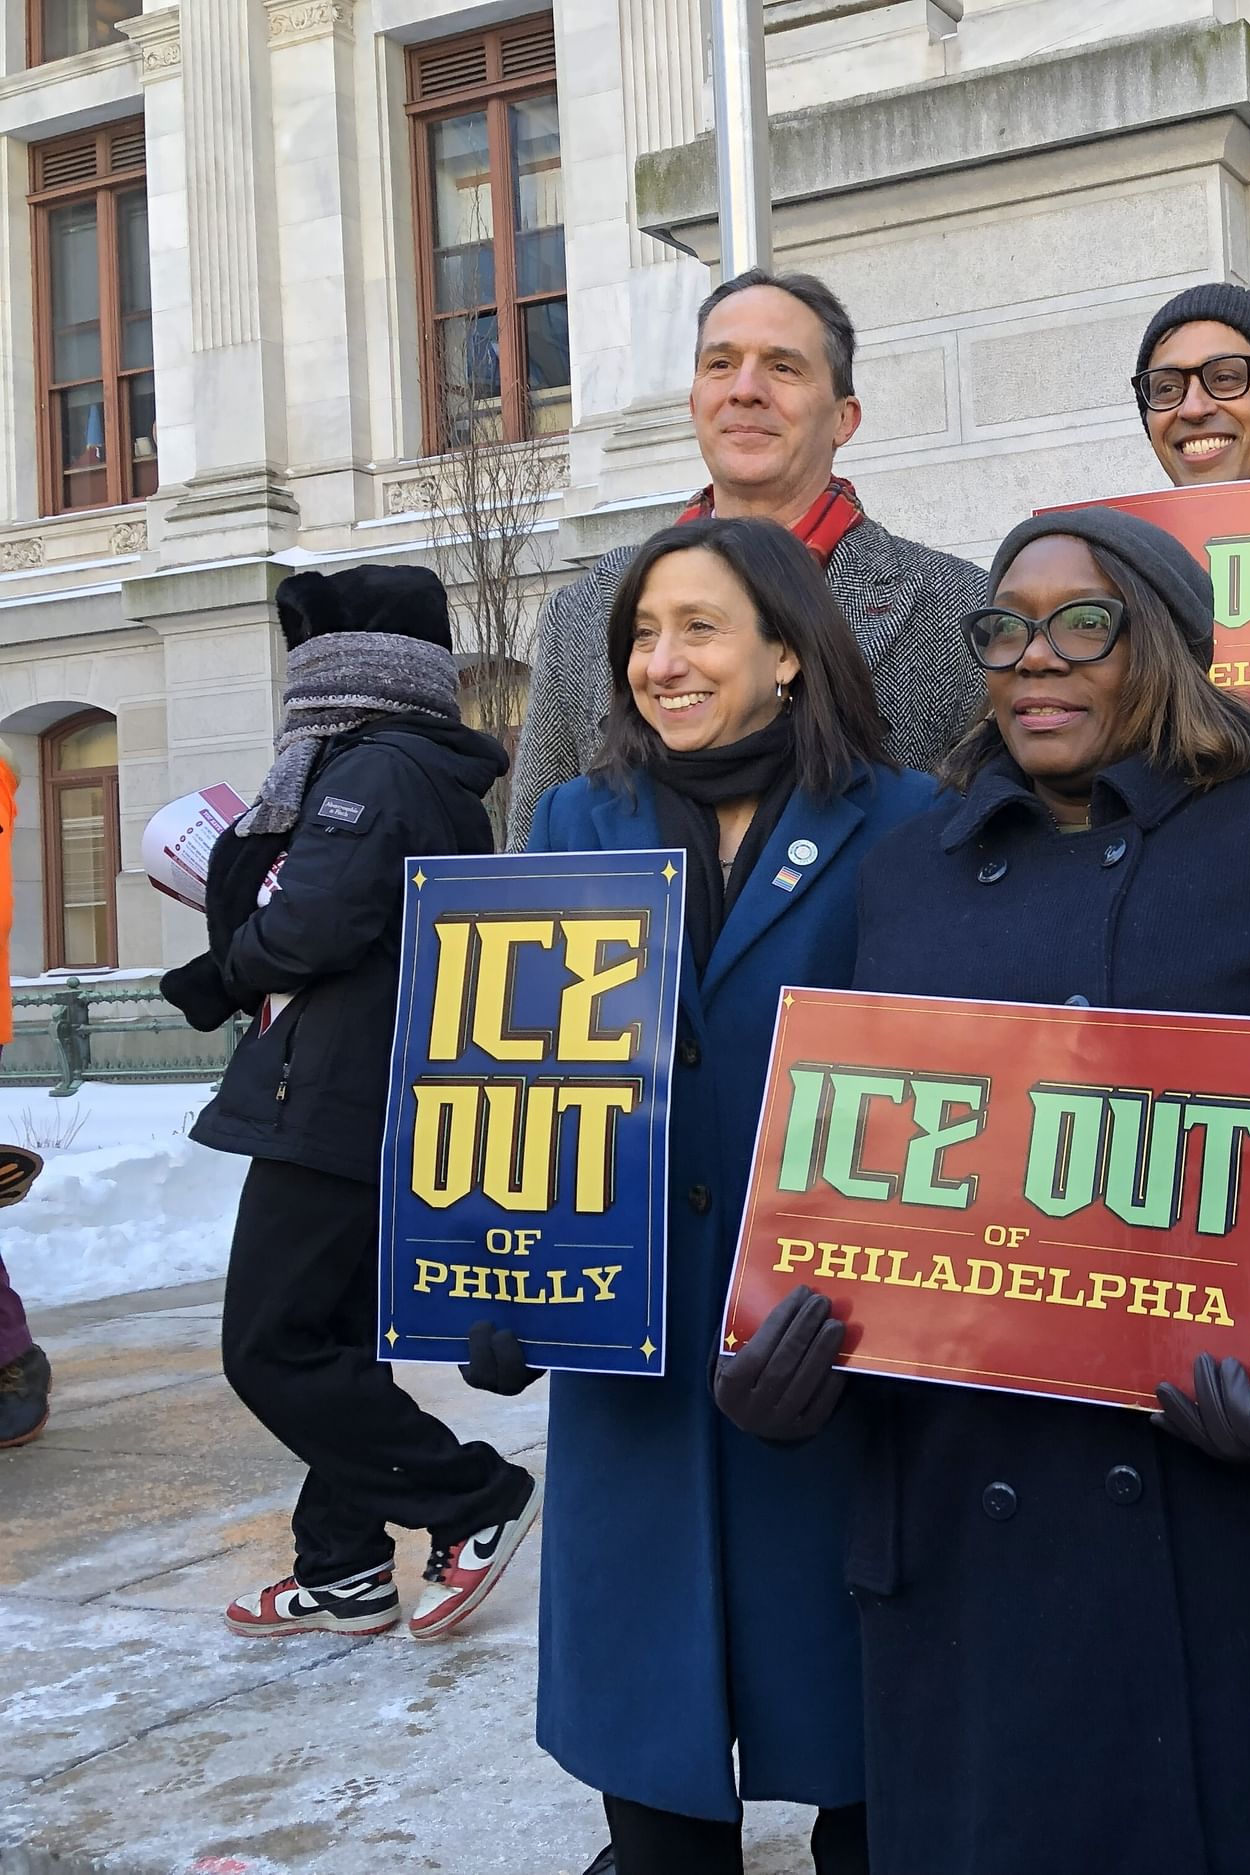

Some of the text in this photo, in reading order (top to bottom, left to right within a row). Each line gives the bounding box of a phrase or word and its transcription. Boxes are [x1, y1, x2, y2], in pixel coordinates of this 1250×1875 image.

[429, 912, 650, 1061] ICE
[411, 1076, 643, 1213] OUT
[777, 1061, 991, 1208] ICE
[412, 1258, 623, 1304] PHILLY
[485, 1228, 542, 1256] OF
[984, 1225, 1030, 1249] OF
[772, 1238, 1234, 1327] PHILADELPHIA
